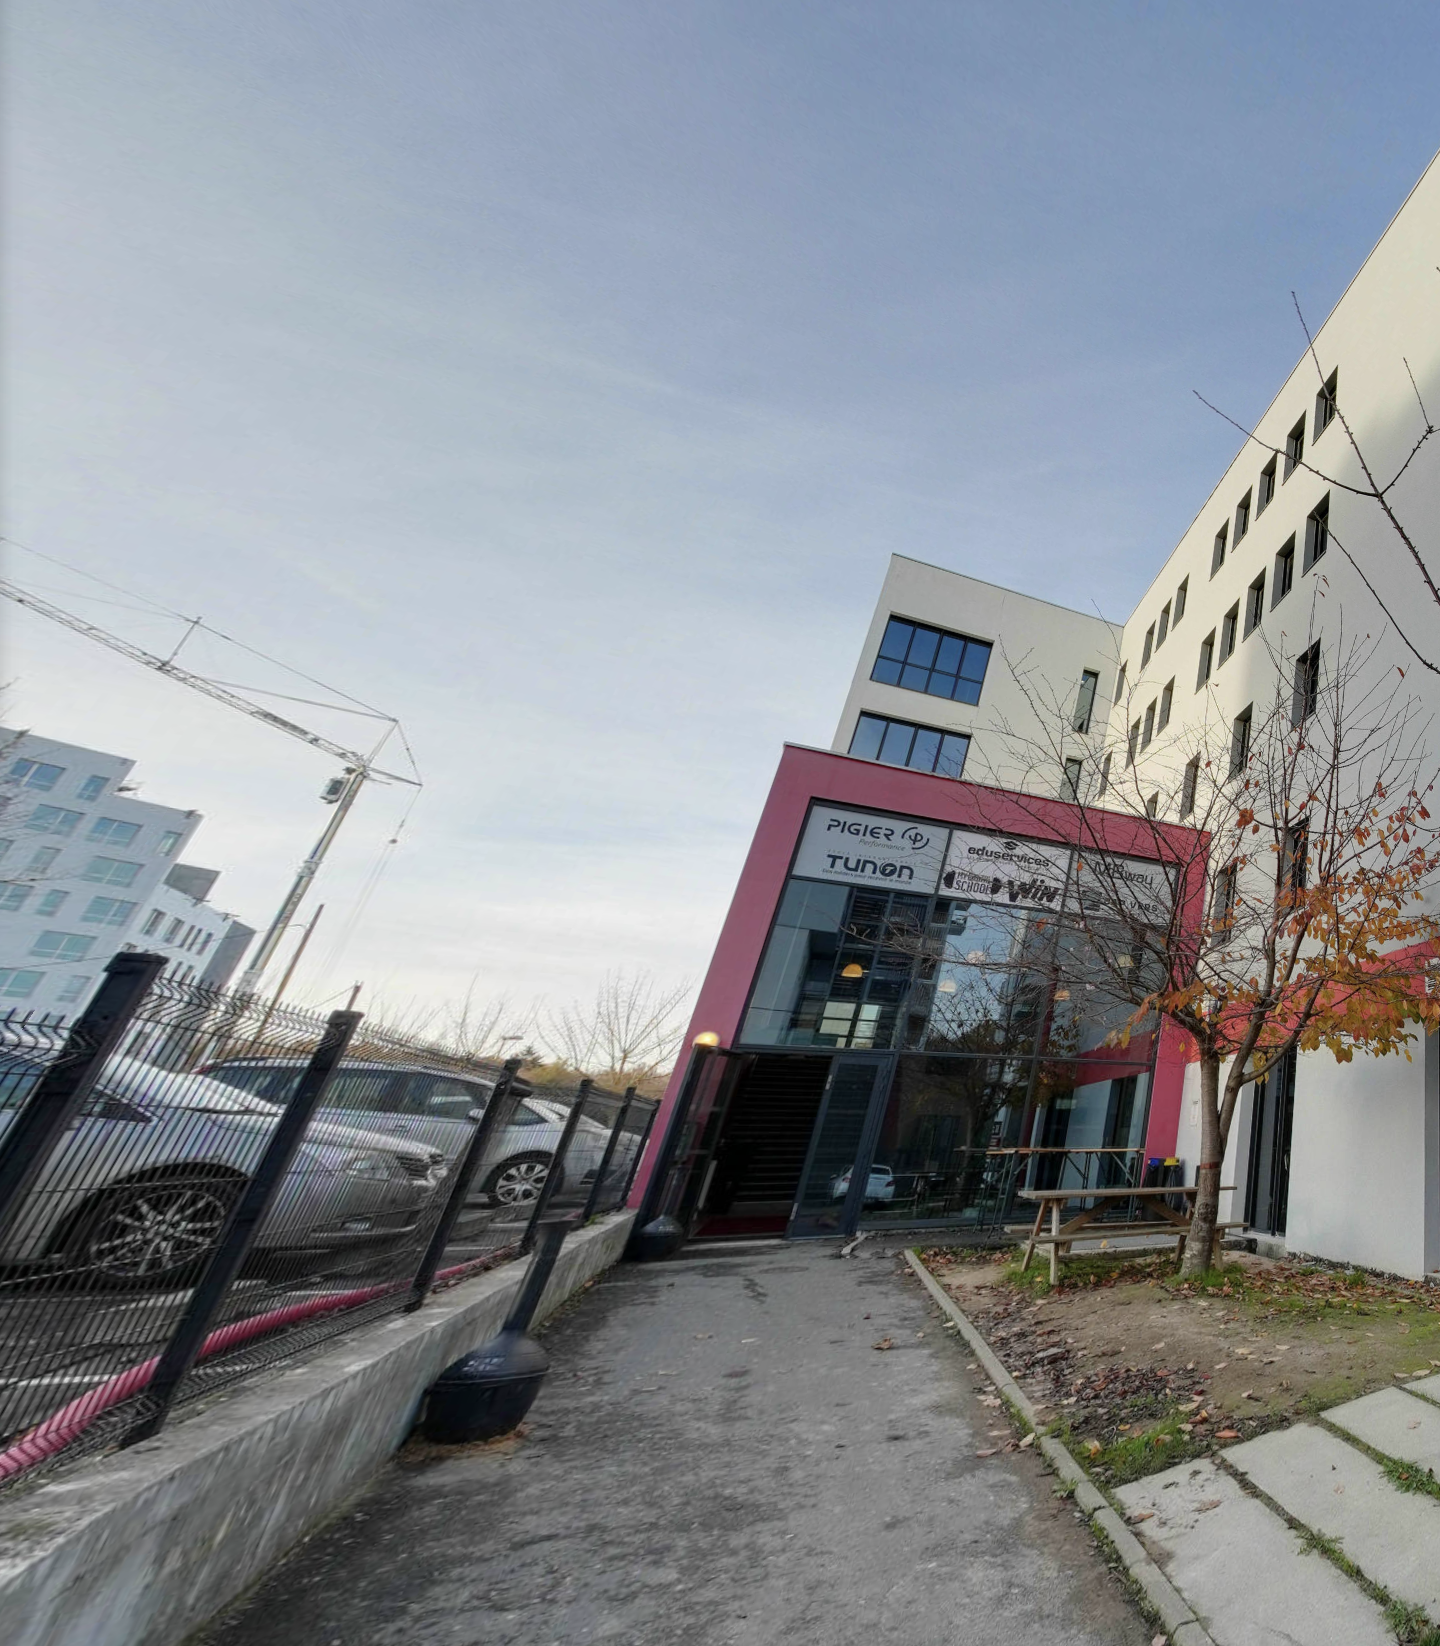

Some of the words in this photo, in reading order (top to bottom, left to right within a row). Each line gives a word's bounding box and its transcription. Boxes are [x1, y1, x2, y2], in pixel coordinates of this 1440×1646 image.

[827, 819, 895, 841] PIGIER
[968, 846, 1050, 867] eduservices
[954, 880, 992, 895] SCHOOL
